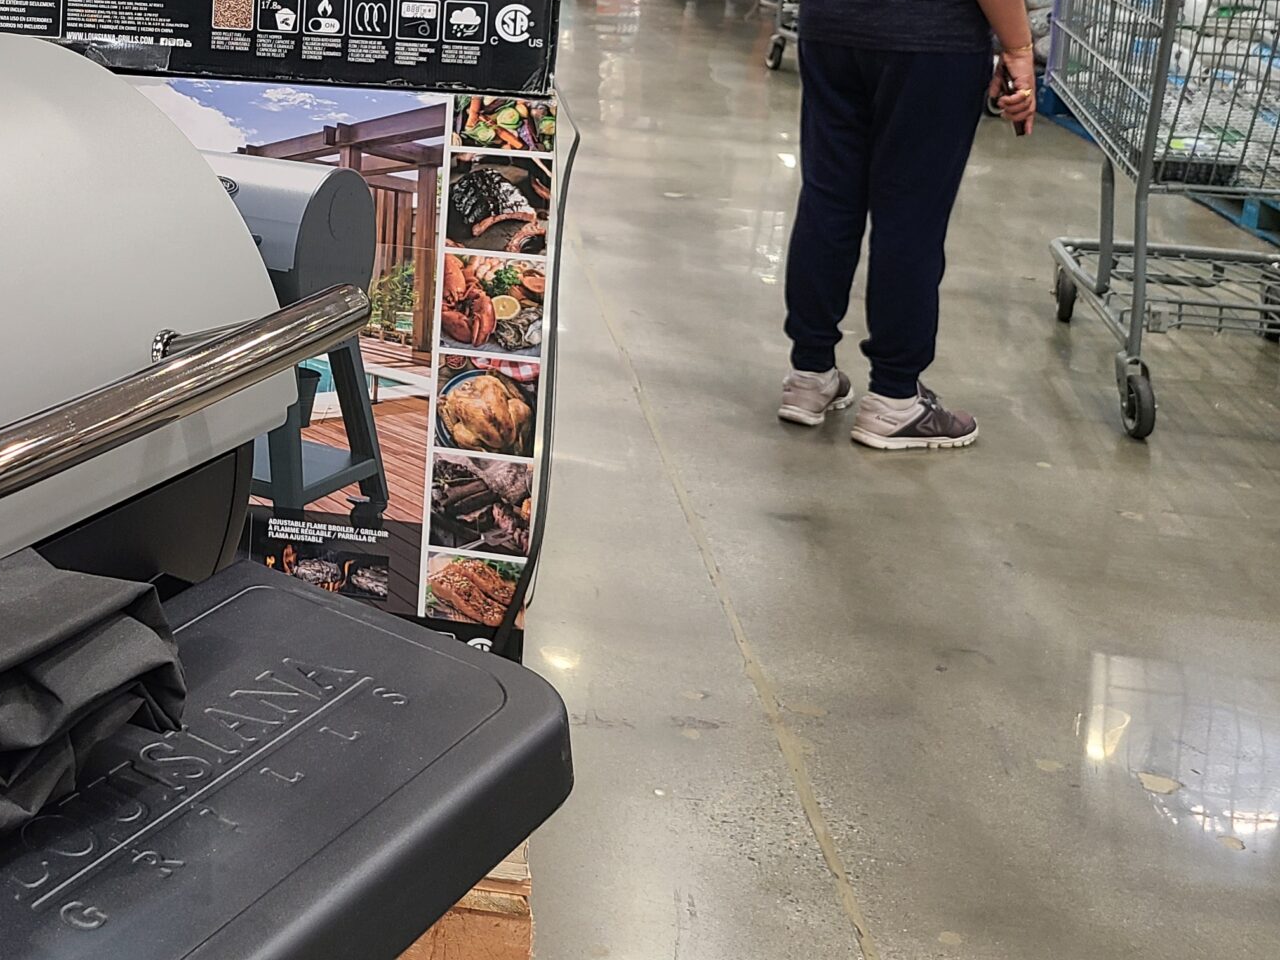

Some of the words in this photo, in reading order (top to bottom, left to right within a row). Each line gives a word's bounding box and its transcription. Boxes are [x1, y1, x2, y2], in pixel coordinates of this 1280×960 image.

[269, 518, 306, 528] ADJUSTABLE
[307, 522, 327, 530] FLAME
[328, 524, 353, 533] BROILER
[361, 528, 389, 537] GRILLOIR
